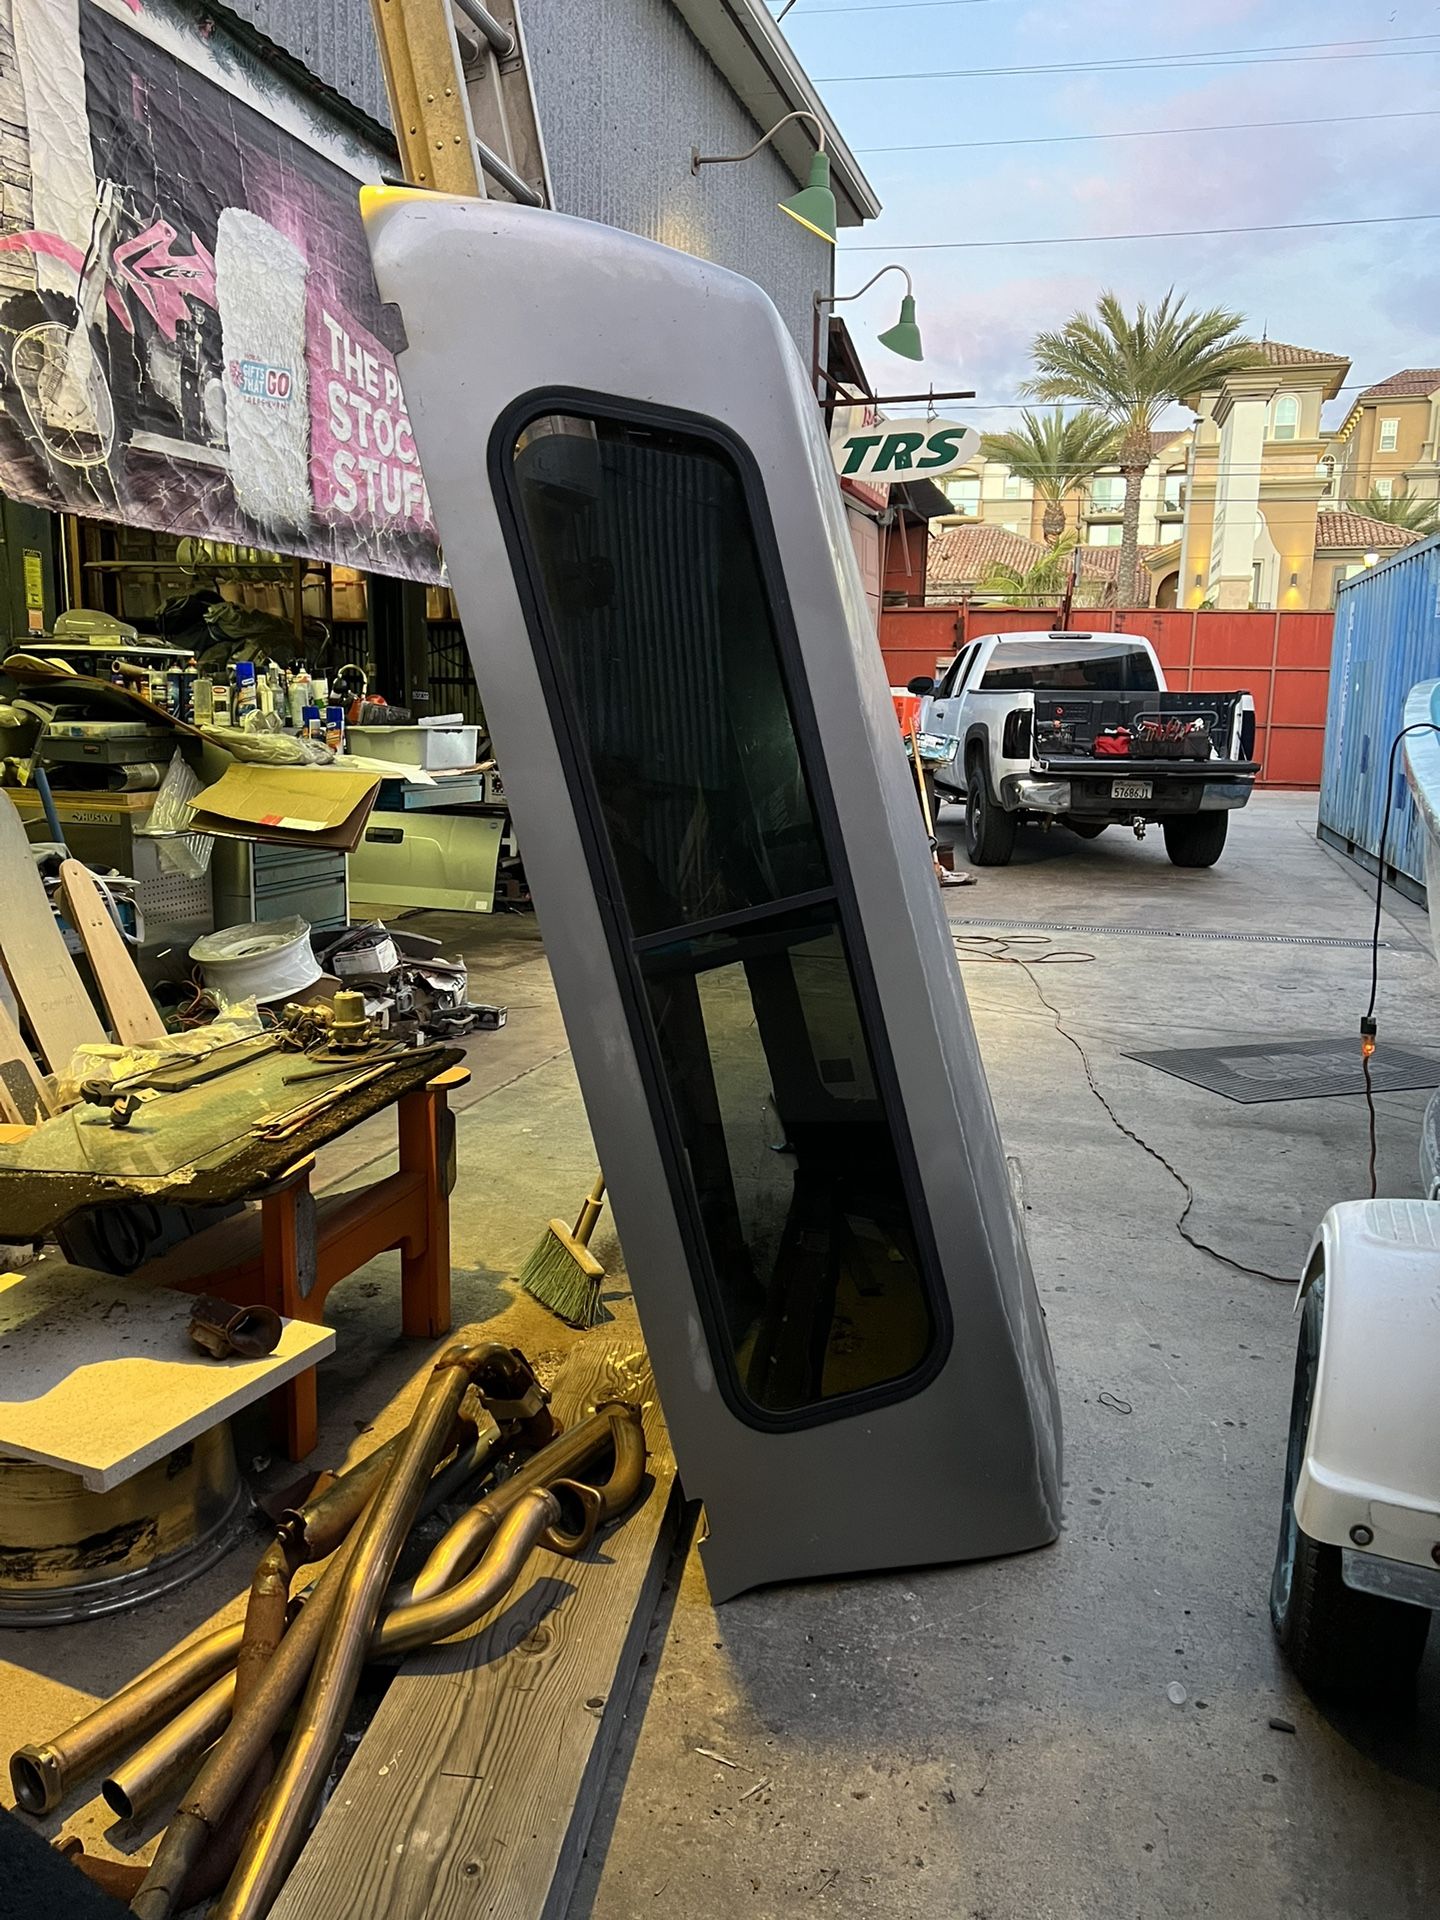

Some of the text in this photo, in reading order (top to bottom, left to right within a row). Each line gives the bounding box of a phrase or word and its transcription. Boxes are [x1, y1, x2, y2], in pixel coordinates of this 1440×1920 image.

[323, 308, 379, 399] THE
[242, 364, 265, 380] GIFTS
[243, 377, 265, 393] THAT
[267, 370, 290, 397] GO
[328, 380, 420, 467] STOC
[841, 428, 968, 475] TRS
[1114, 787, 1148, 798] 57686J1
[82, 813, 113, 823] HUSKY
